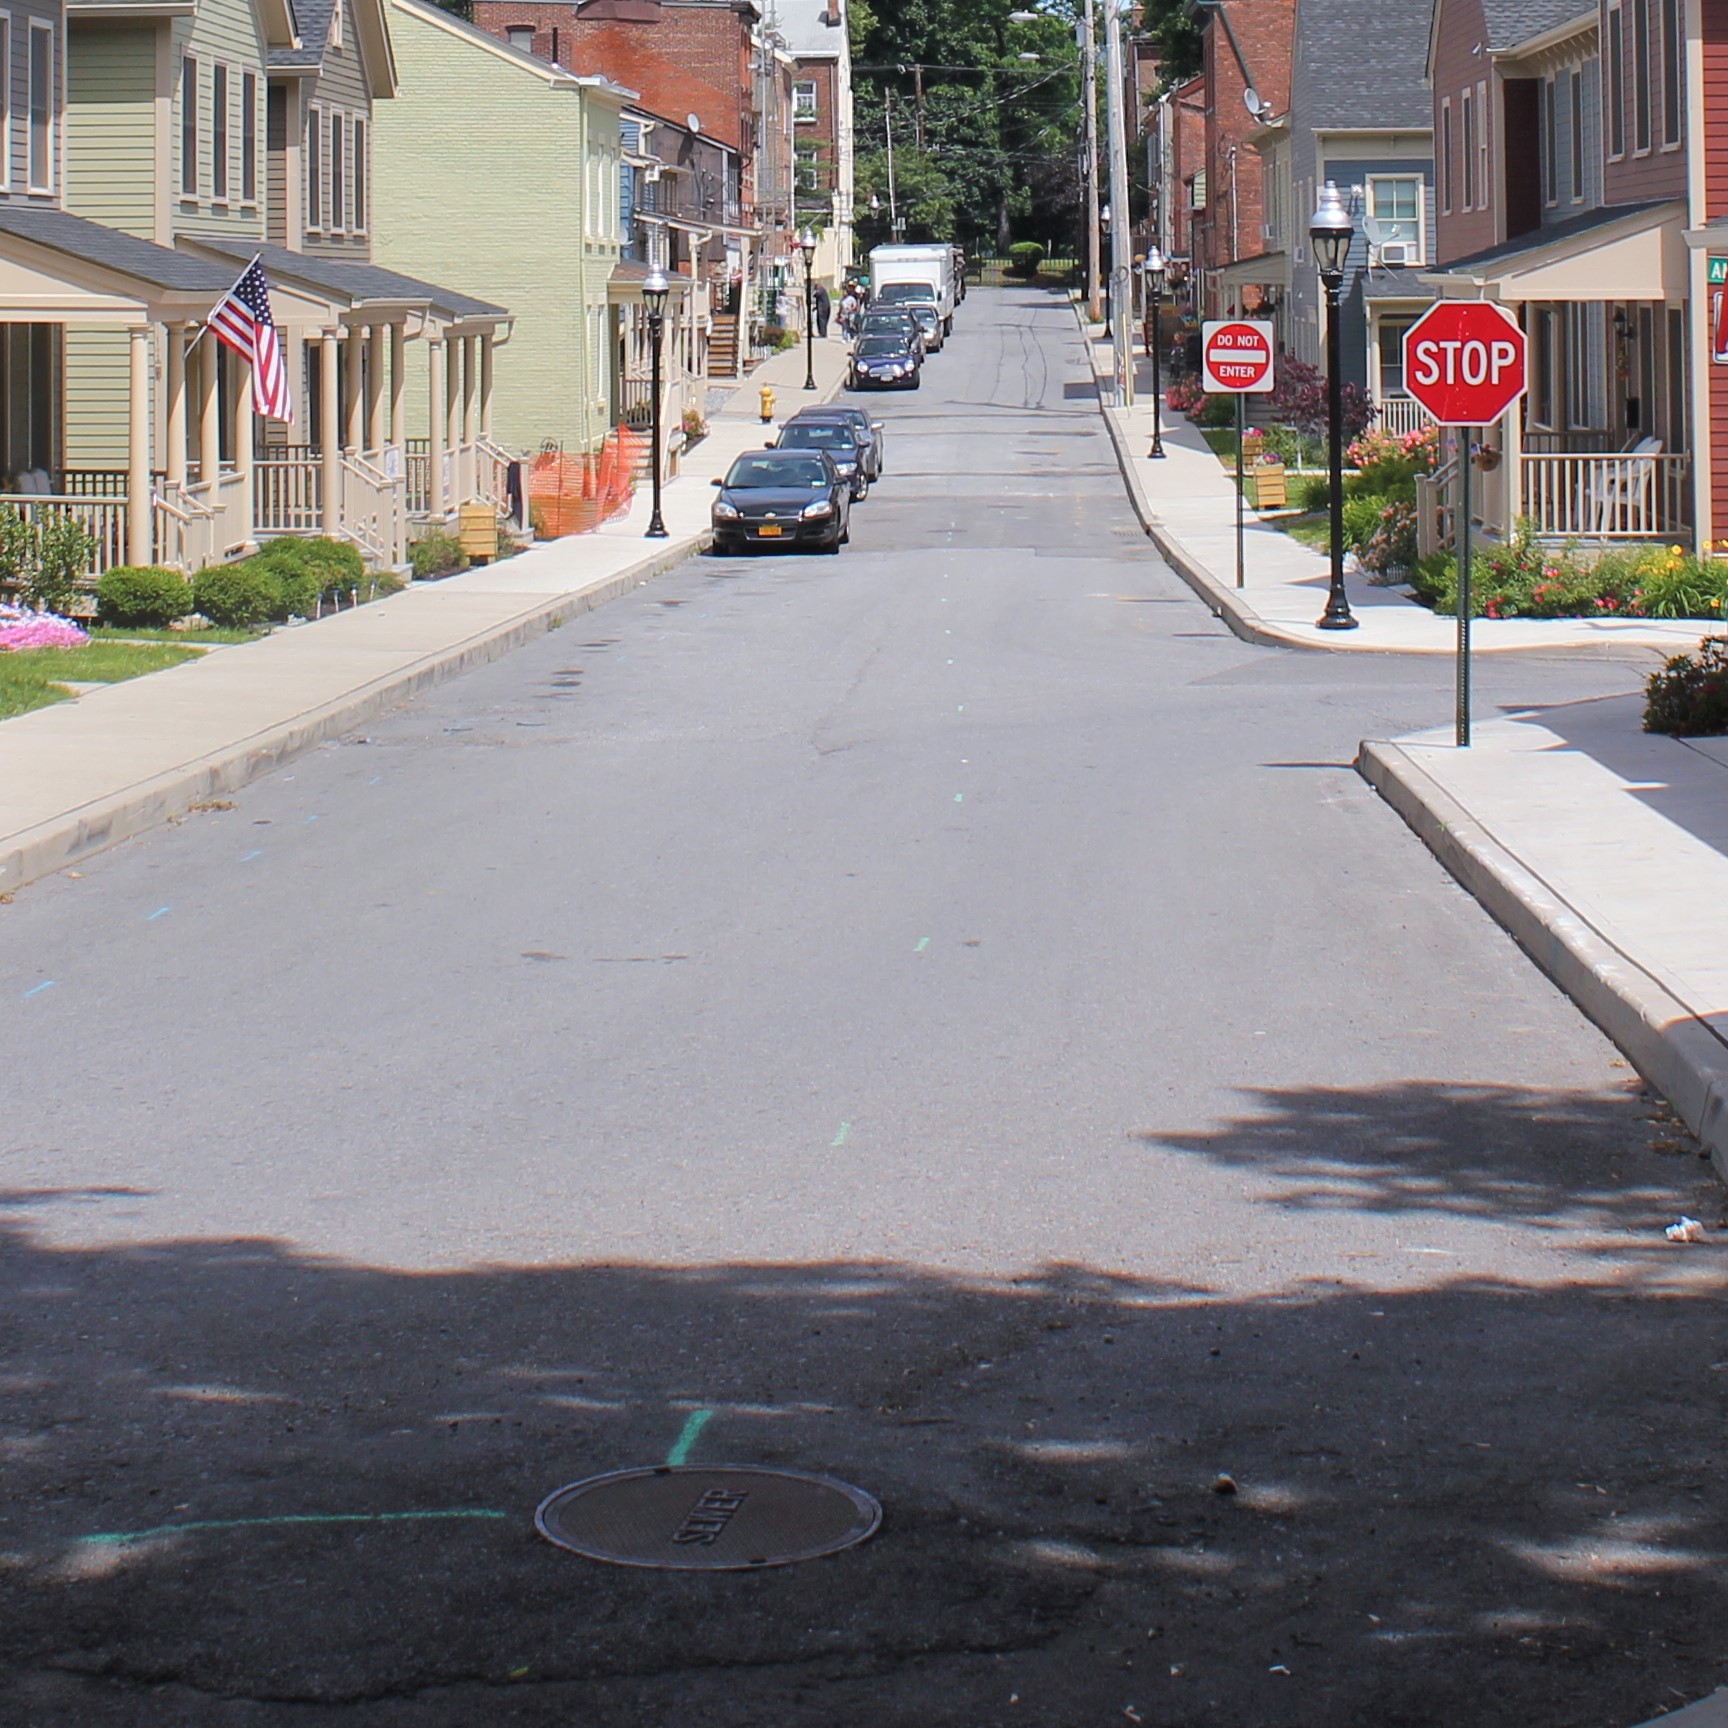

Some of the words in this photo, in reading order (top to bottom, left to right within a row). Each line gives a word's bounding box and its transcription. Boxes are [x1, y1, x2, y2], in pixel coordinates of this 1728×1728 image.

[1217, 334, 1233, 347] DO
[1237, 335, 1259, 347] NOT
[1219, 365, 1255, 378] ENTER
[1414, 340, 1516, 386] STOP
[672, 1488, 749, 1545] SEWER
